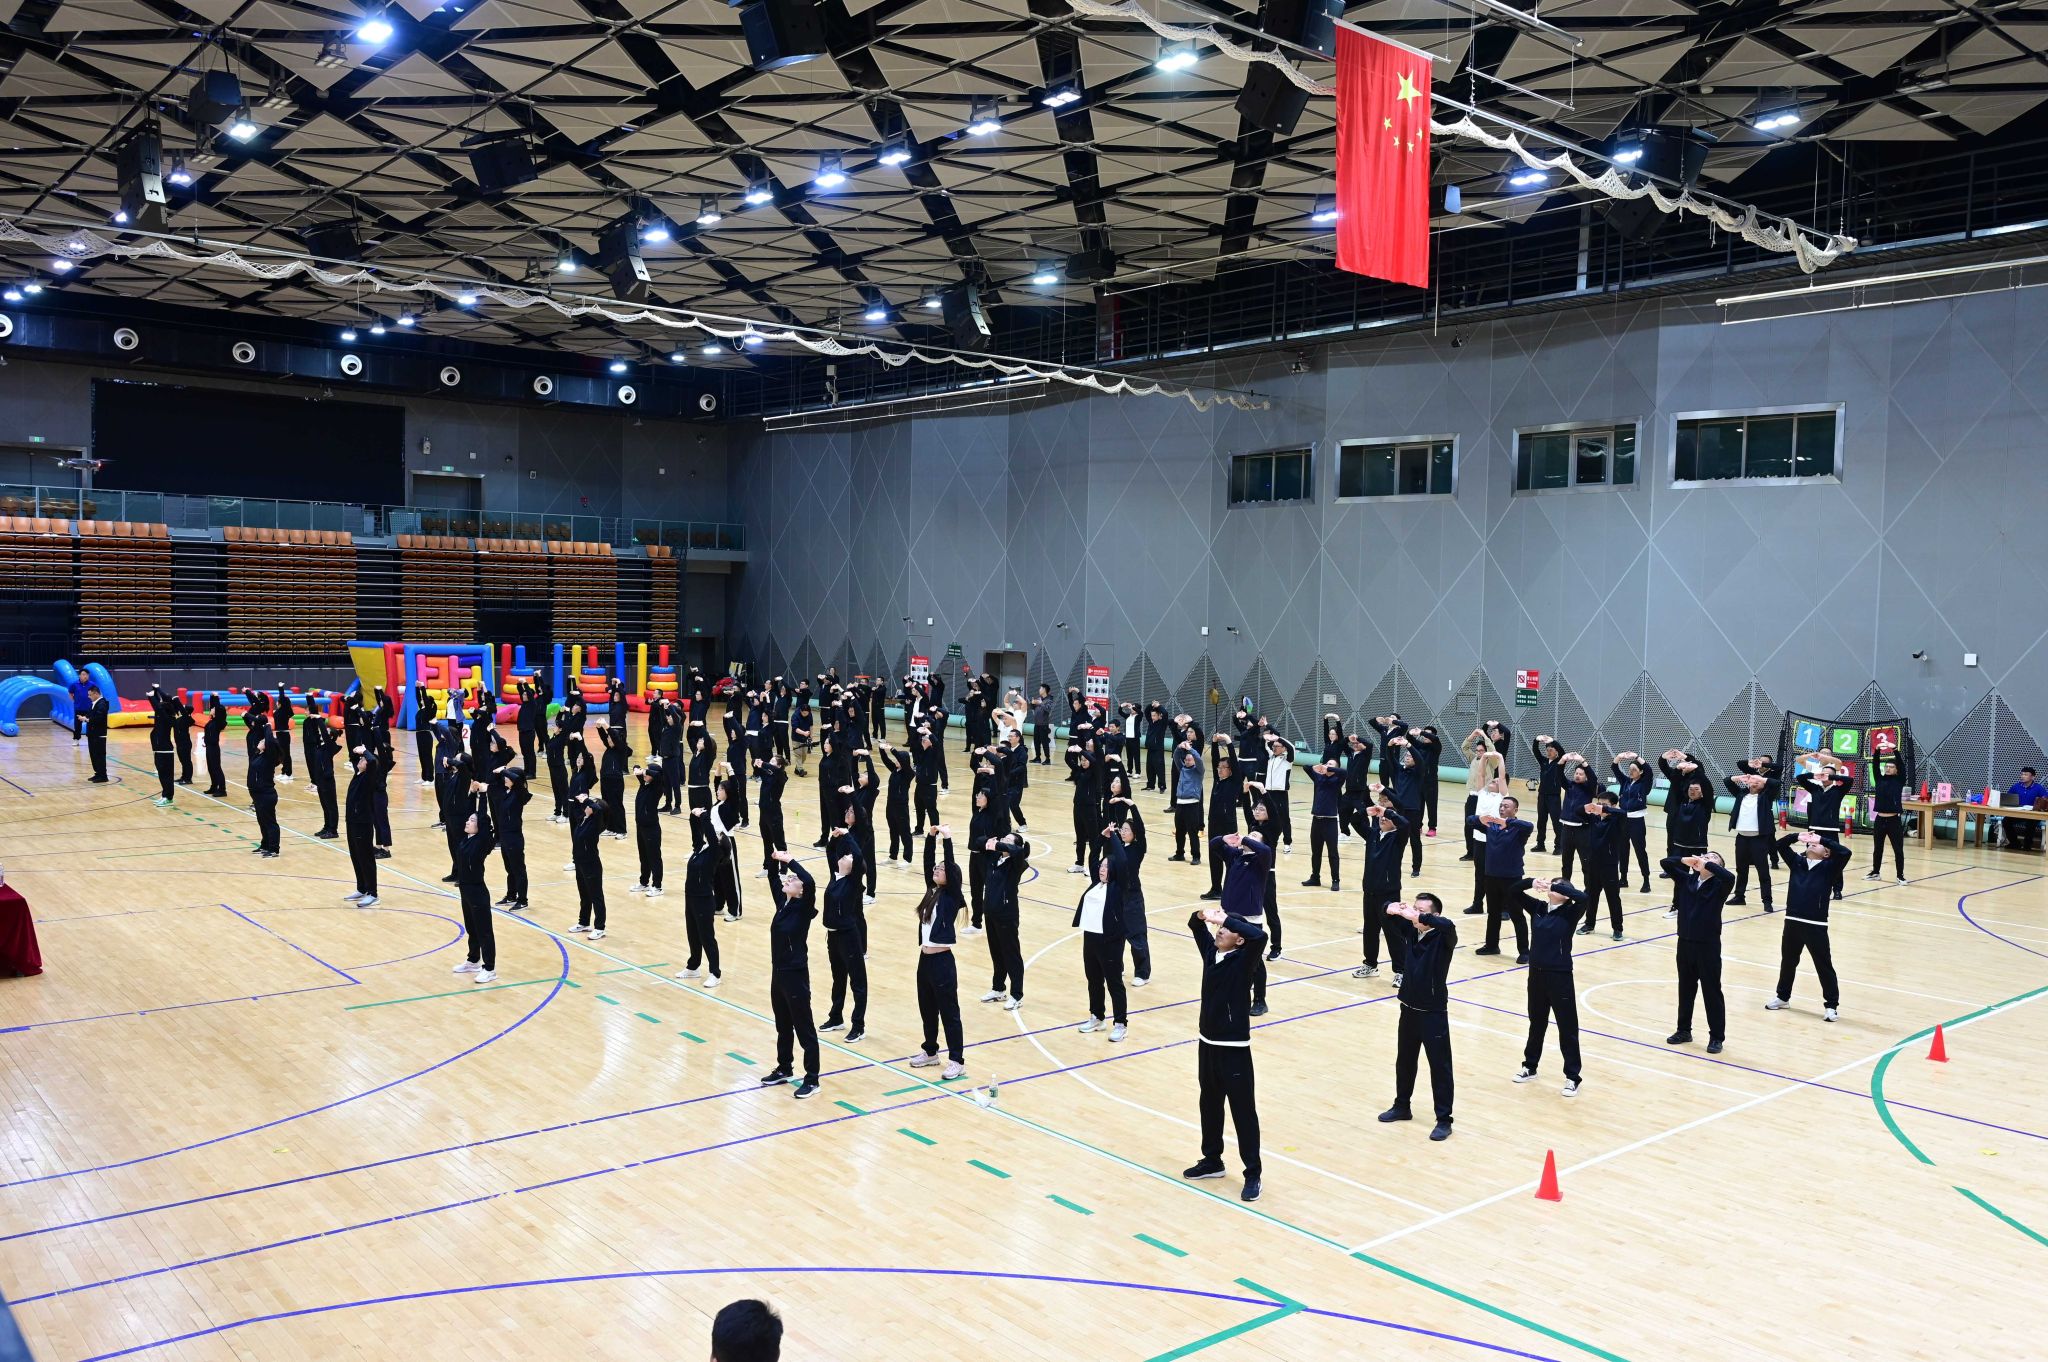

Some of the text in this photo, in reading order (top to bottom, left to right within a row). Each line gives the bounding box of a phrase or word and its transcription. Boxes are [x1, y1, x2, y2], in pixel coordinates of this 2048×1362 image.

[462, 728, 468, 739] 2
[1803, 728, 1813, 745] 1
[1839, 733, 1852, 750] 2
[1876, 732, 1889, 750] 3
